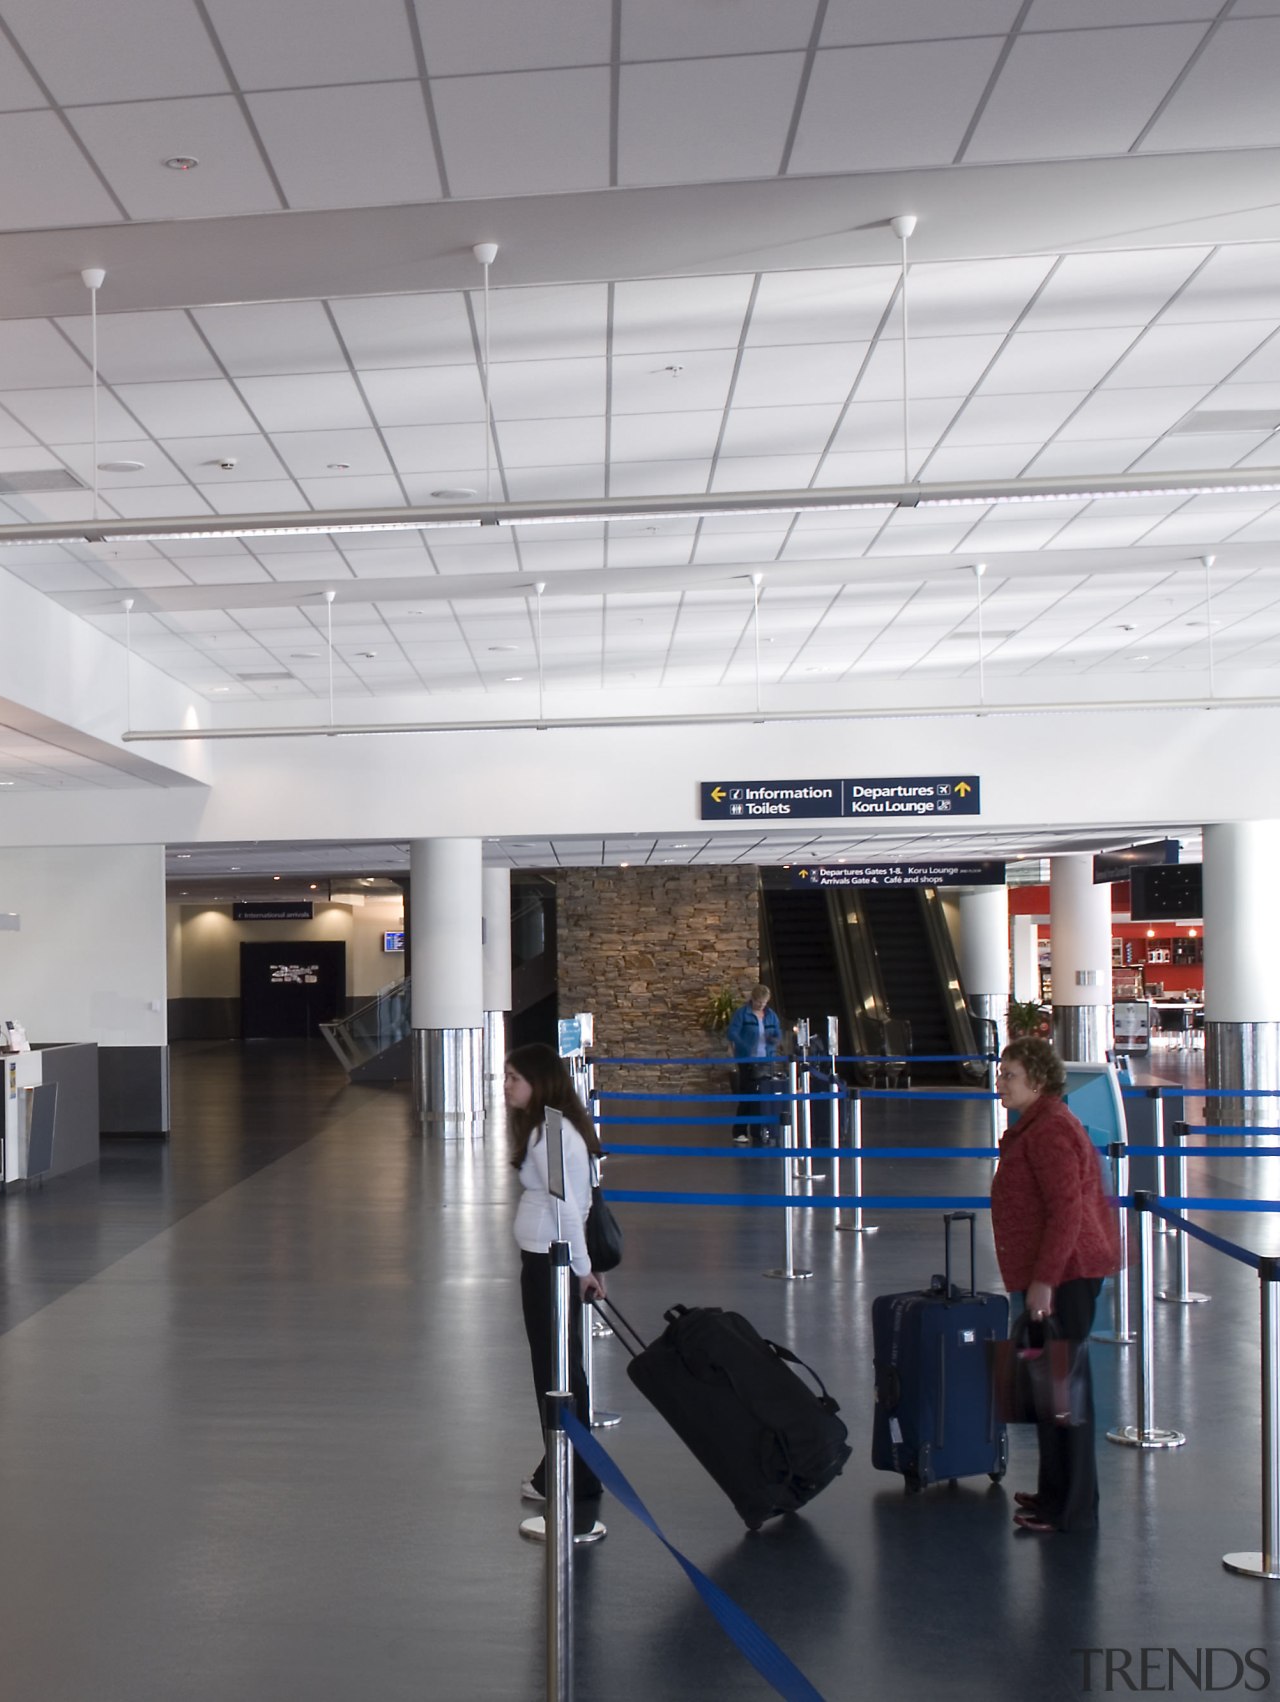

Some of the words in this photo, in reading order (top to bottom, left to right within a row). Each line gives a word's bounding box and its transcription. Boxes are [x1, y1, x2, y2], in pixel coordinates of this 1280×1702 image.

[745, 786, 832, 800] Information
[852, 785, 934, 801] Departures
[746, 802, 791, 815] Toilets
[852, 802, 884, 814] Koru
[885, 800, 934, 814] Lounge
[820, 868, 864, 877] Departures
[864, 868, 888, 876] Gates
[929, 866, 959, 876] Lounge
[820, 877, 850, 885] Arrivals
[851, 876, 870, 884] Gate
[884, 876, 902, 884] Café
[903, 876, 919, 884] and
[920, 876, 944, 884] shops
